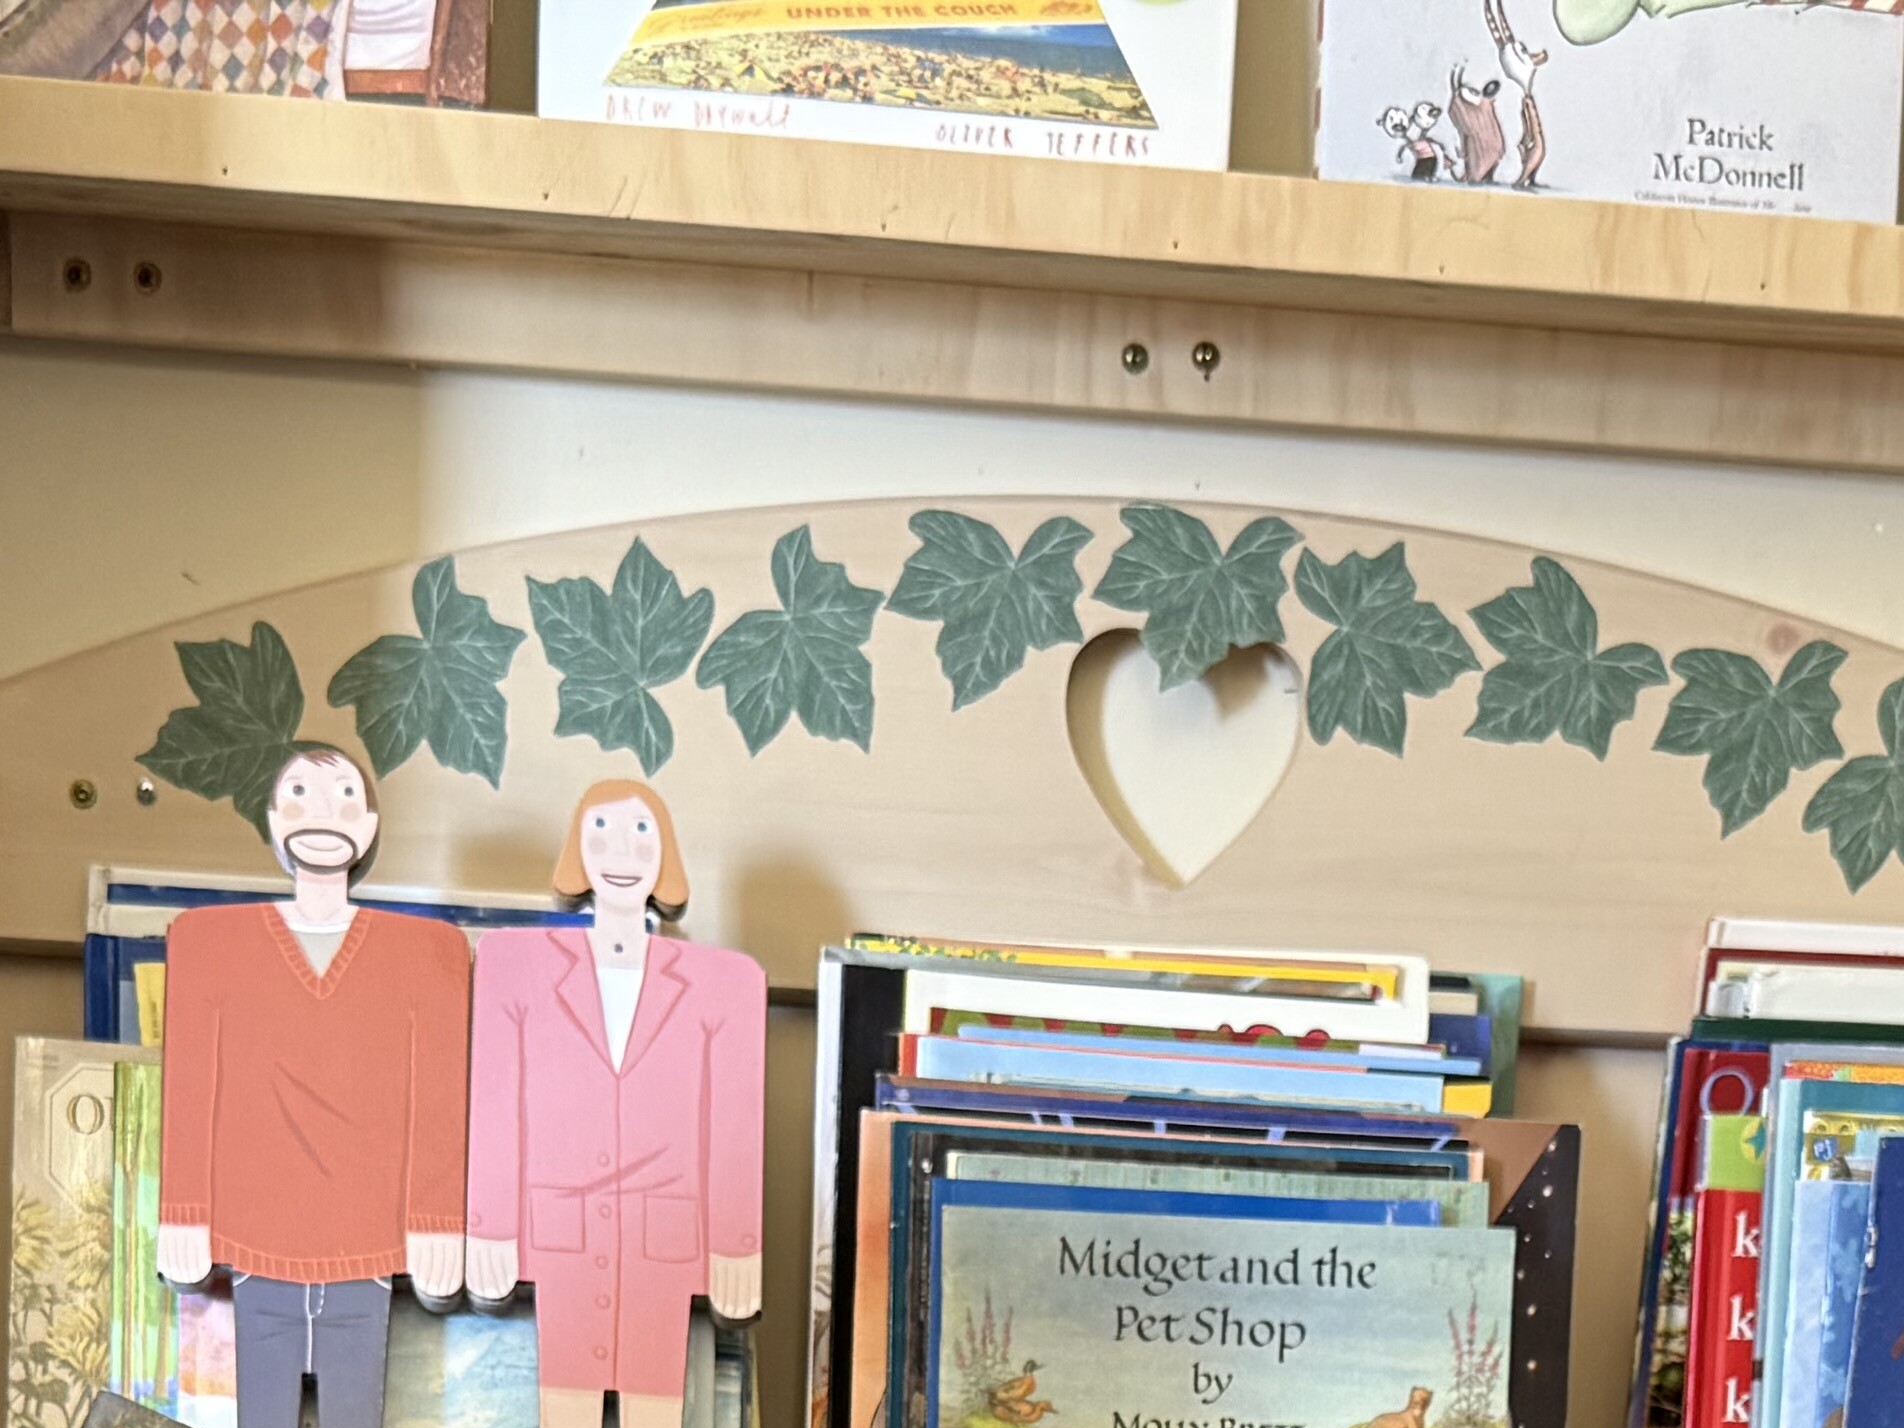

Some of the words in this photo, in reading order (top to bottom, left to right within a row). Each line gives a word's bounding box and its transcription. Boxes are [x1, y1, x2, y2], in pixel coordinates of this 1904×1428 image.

[787, 6, 865, 19] UNDER
[873, 6, 912, 19] THE
[936, 124, 1014, 148] OLIVER
[1686, 118, 1774, 151] Patrick
[1653, 152, 1804, 191] McDonnell
[1059, 1236, 1214, 1296] Midget
[1219, 1247, 1300, 1287] and
[1312, 1245, 1376, 1289] the
[1114, 1305, 1185, 1343] Pet
[1189, 1307, 1306, 1363] Shop
[1192, 1363, 1233, 1404] by
